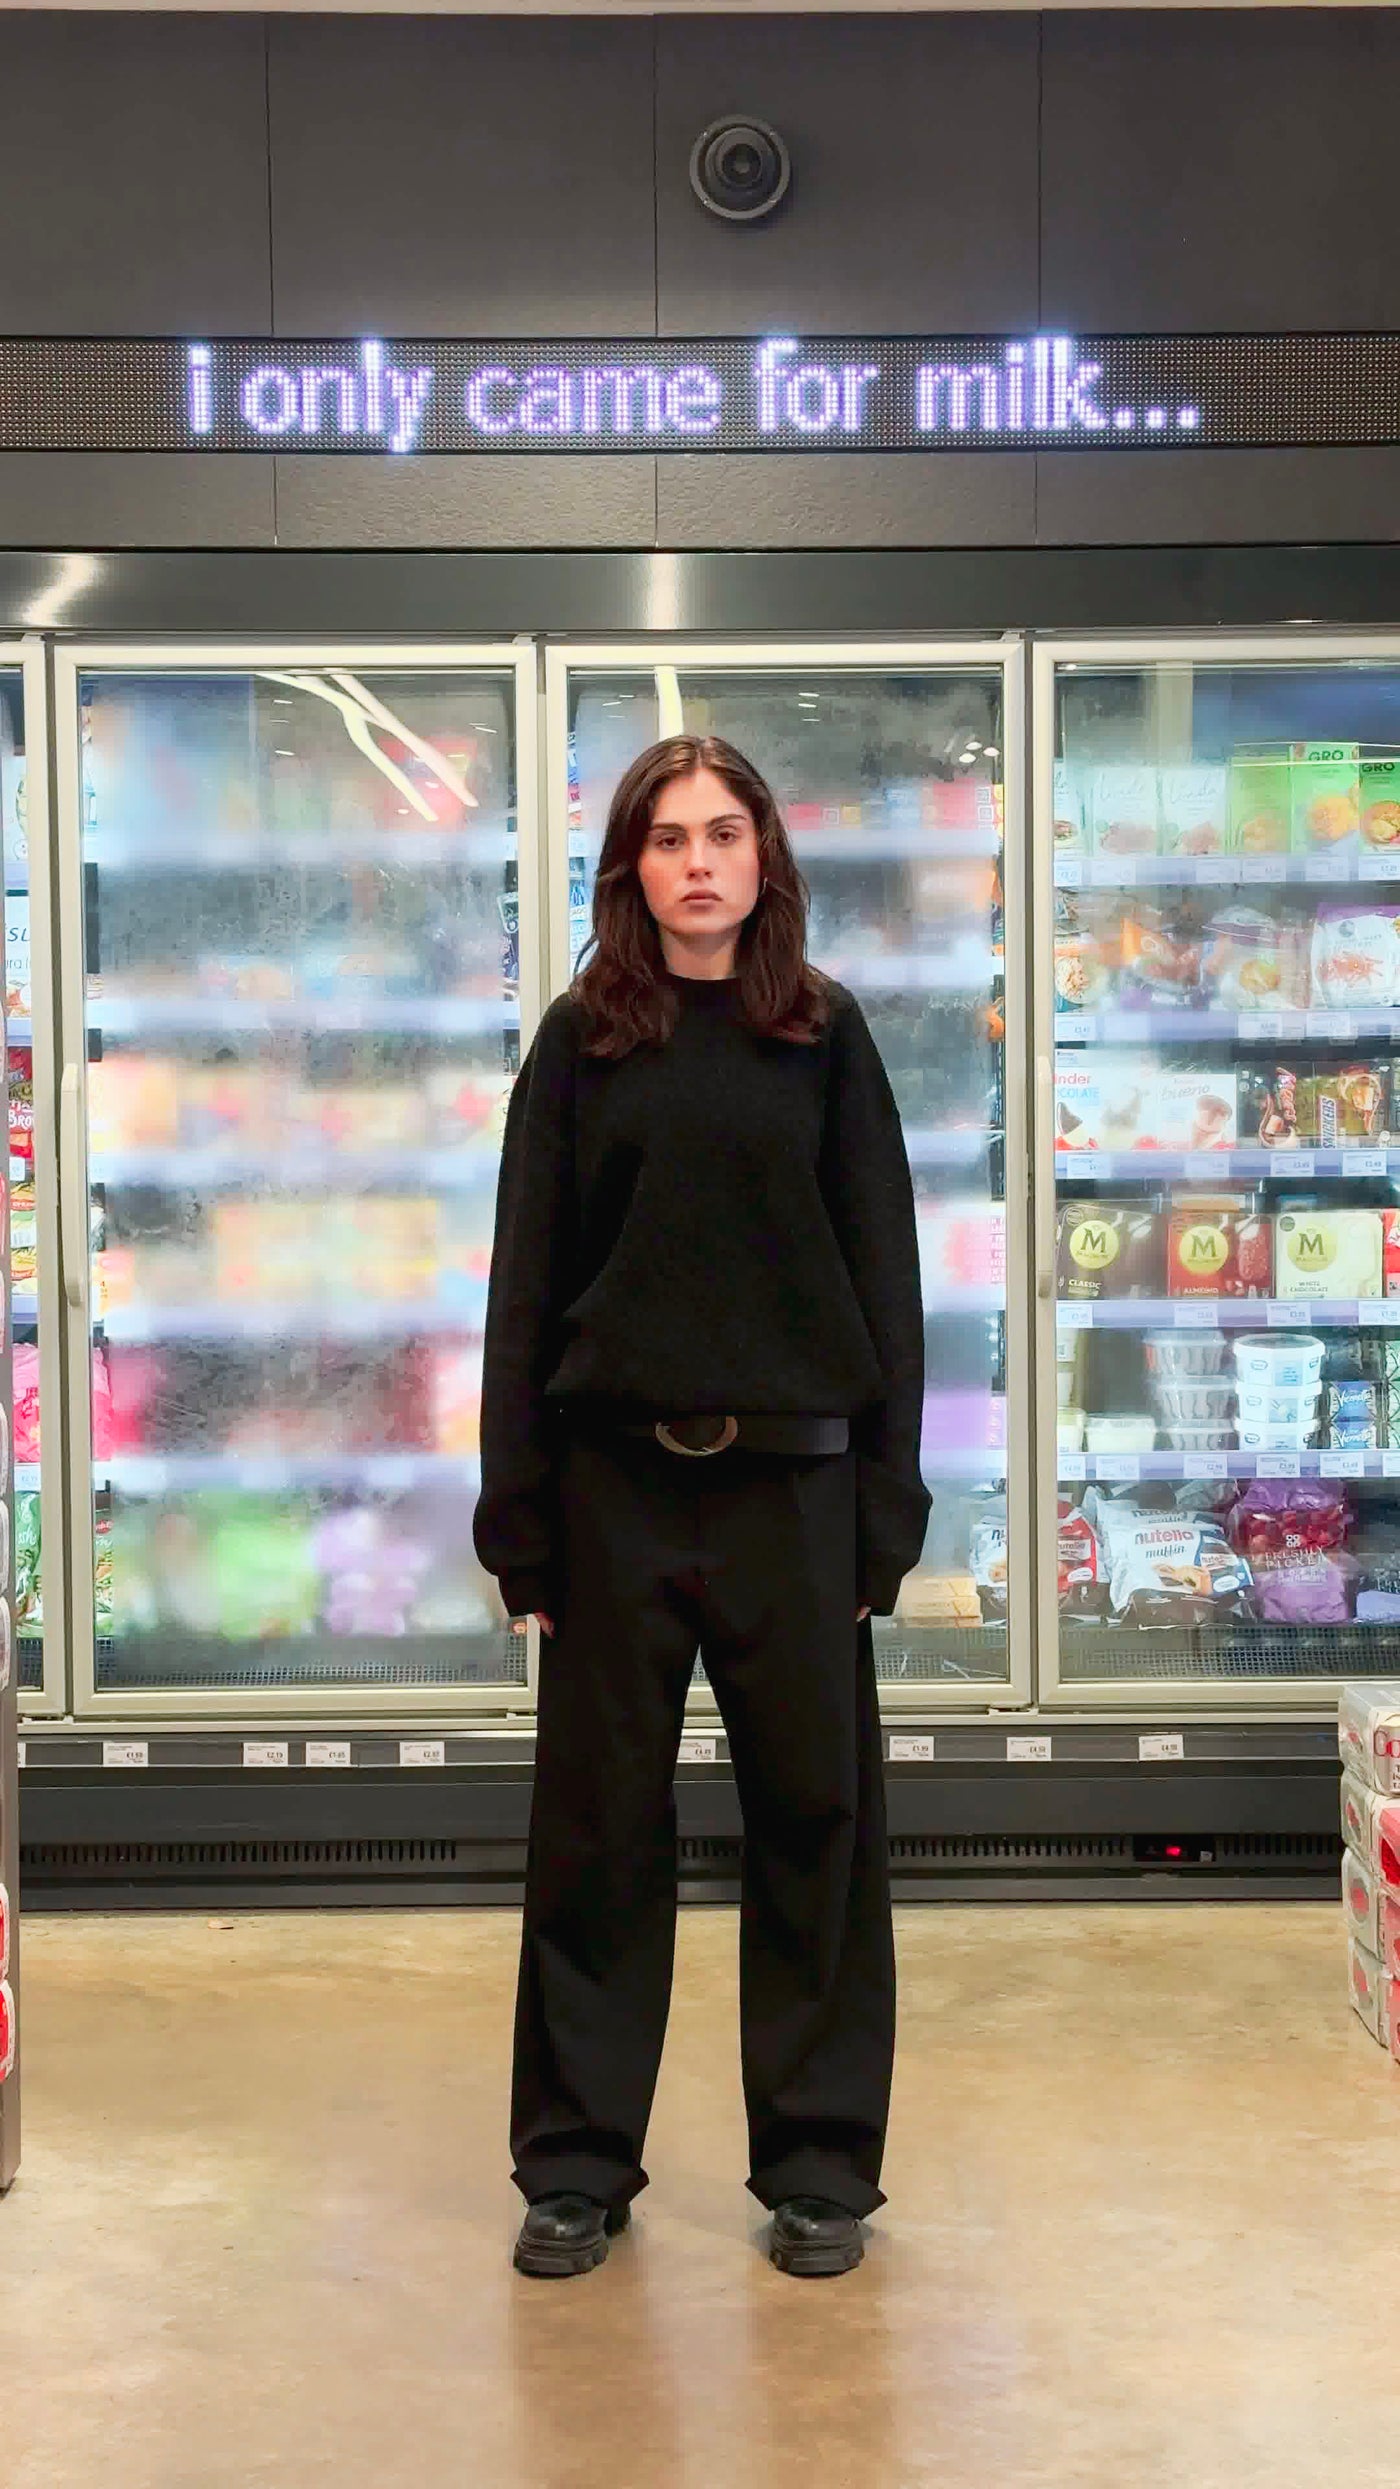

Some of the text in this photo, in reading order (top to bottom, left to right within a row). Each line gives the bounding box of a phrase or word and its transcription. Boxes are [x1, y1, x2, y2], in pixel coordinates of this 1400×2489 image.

[190, 337, 1200, 452] i only came for milk...
[1308, 750, 1344, 761] GRO
[1361, 762, 1395, 773] GRO
[8, 1109, 33, 1129] BRO
[1322, 1098, 1337, 1149] SNICKERS
[1080, 1228, 1107, 1252] M
[1190, 1235, 1217, 1257] M
[1298, 1233, 1325, 1255] M
[1068, 1278, 1103, 1290] CLASSIC
[1134, 1529, 1194, 1545] nutella
[1145, 1544, 1186, 1559] muffin
